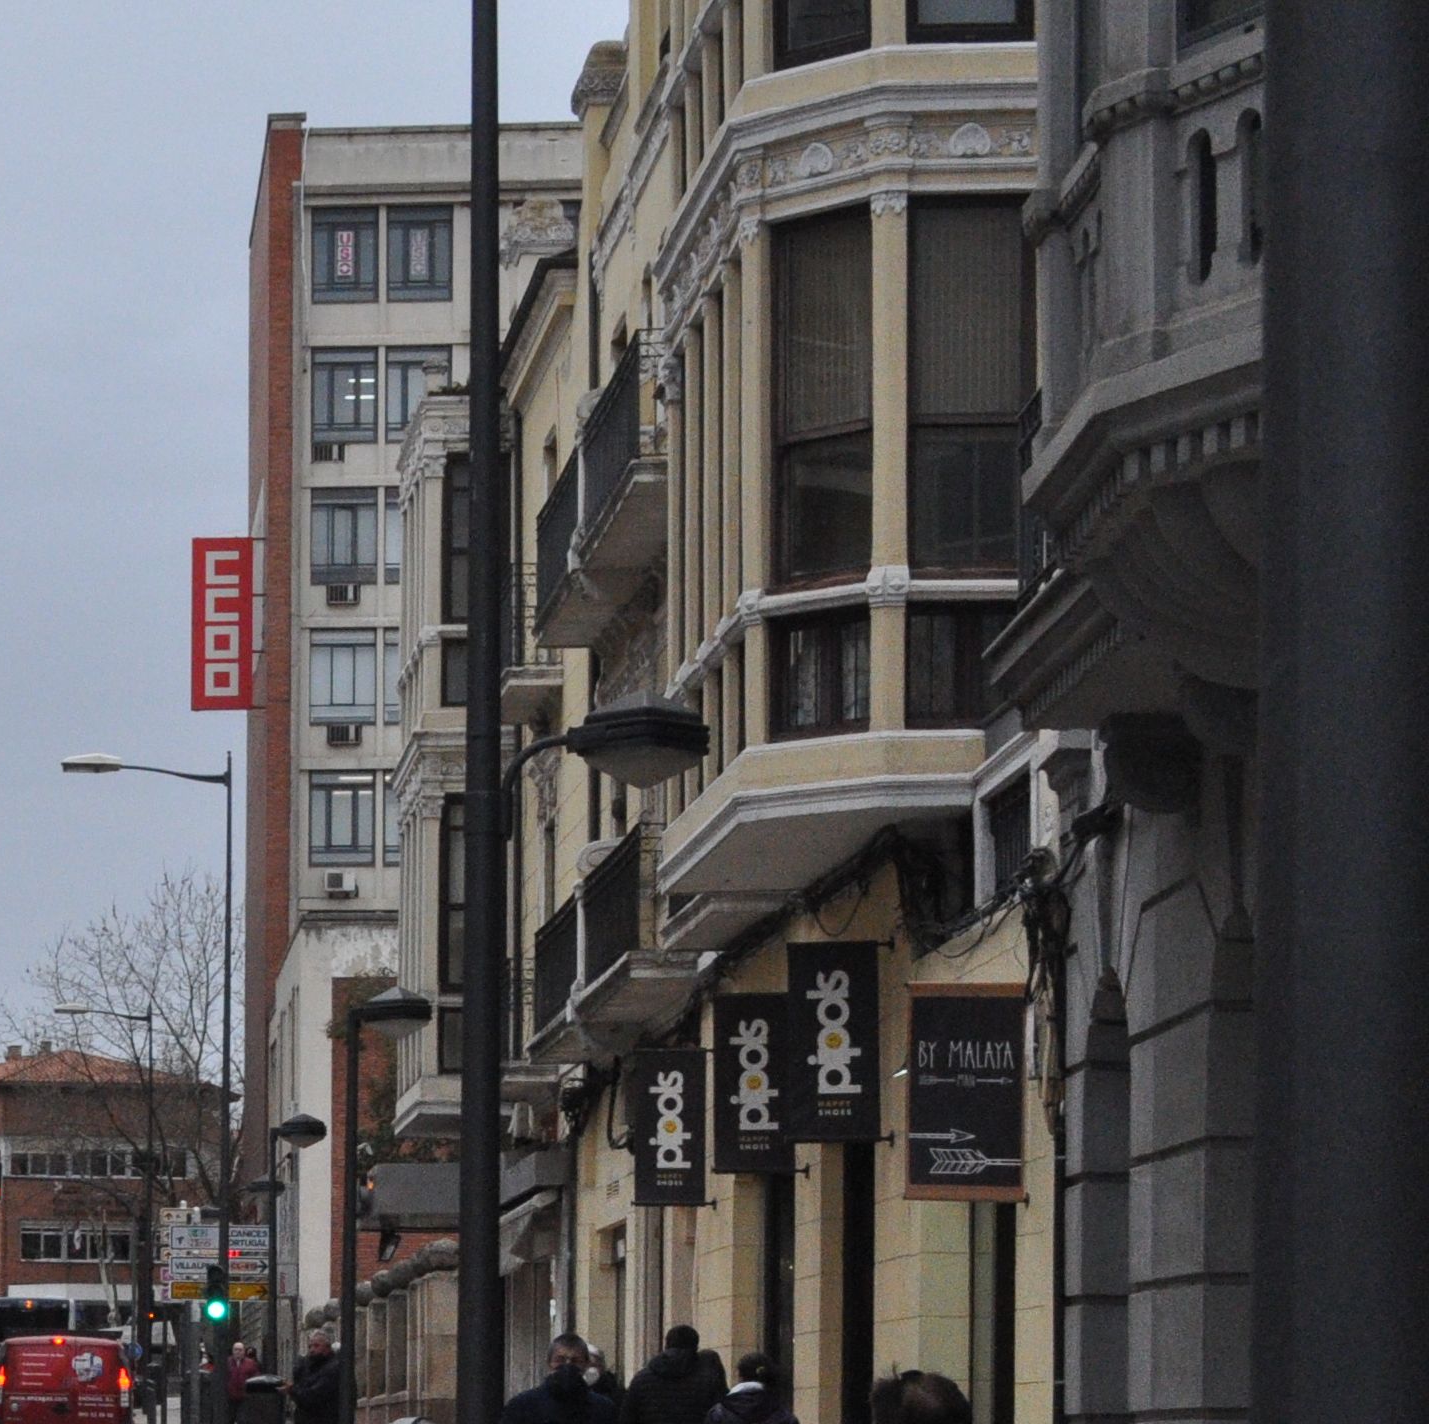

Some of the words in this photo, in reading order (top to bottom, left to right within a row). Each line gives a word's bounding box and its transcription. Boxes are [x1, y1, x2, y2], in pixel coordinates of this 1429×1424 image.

[205, 551, 239, 696] CCOO
[730, 1018, 779, 1130] pipols
[806, 970, 861, 1094] pipols
[918, 1040, 938, 1069] BY
[948, 1040, 1015, 1070] MALAYA
[649, 1071, 691, 1169] pipols
